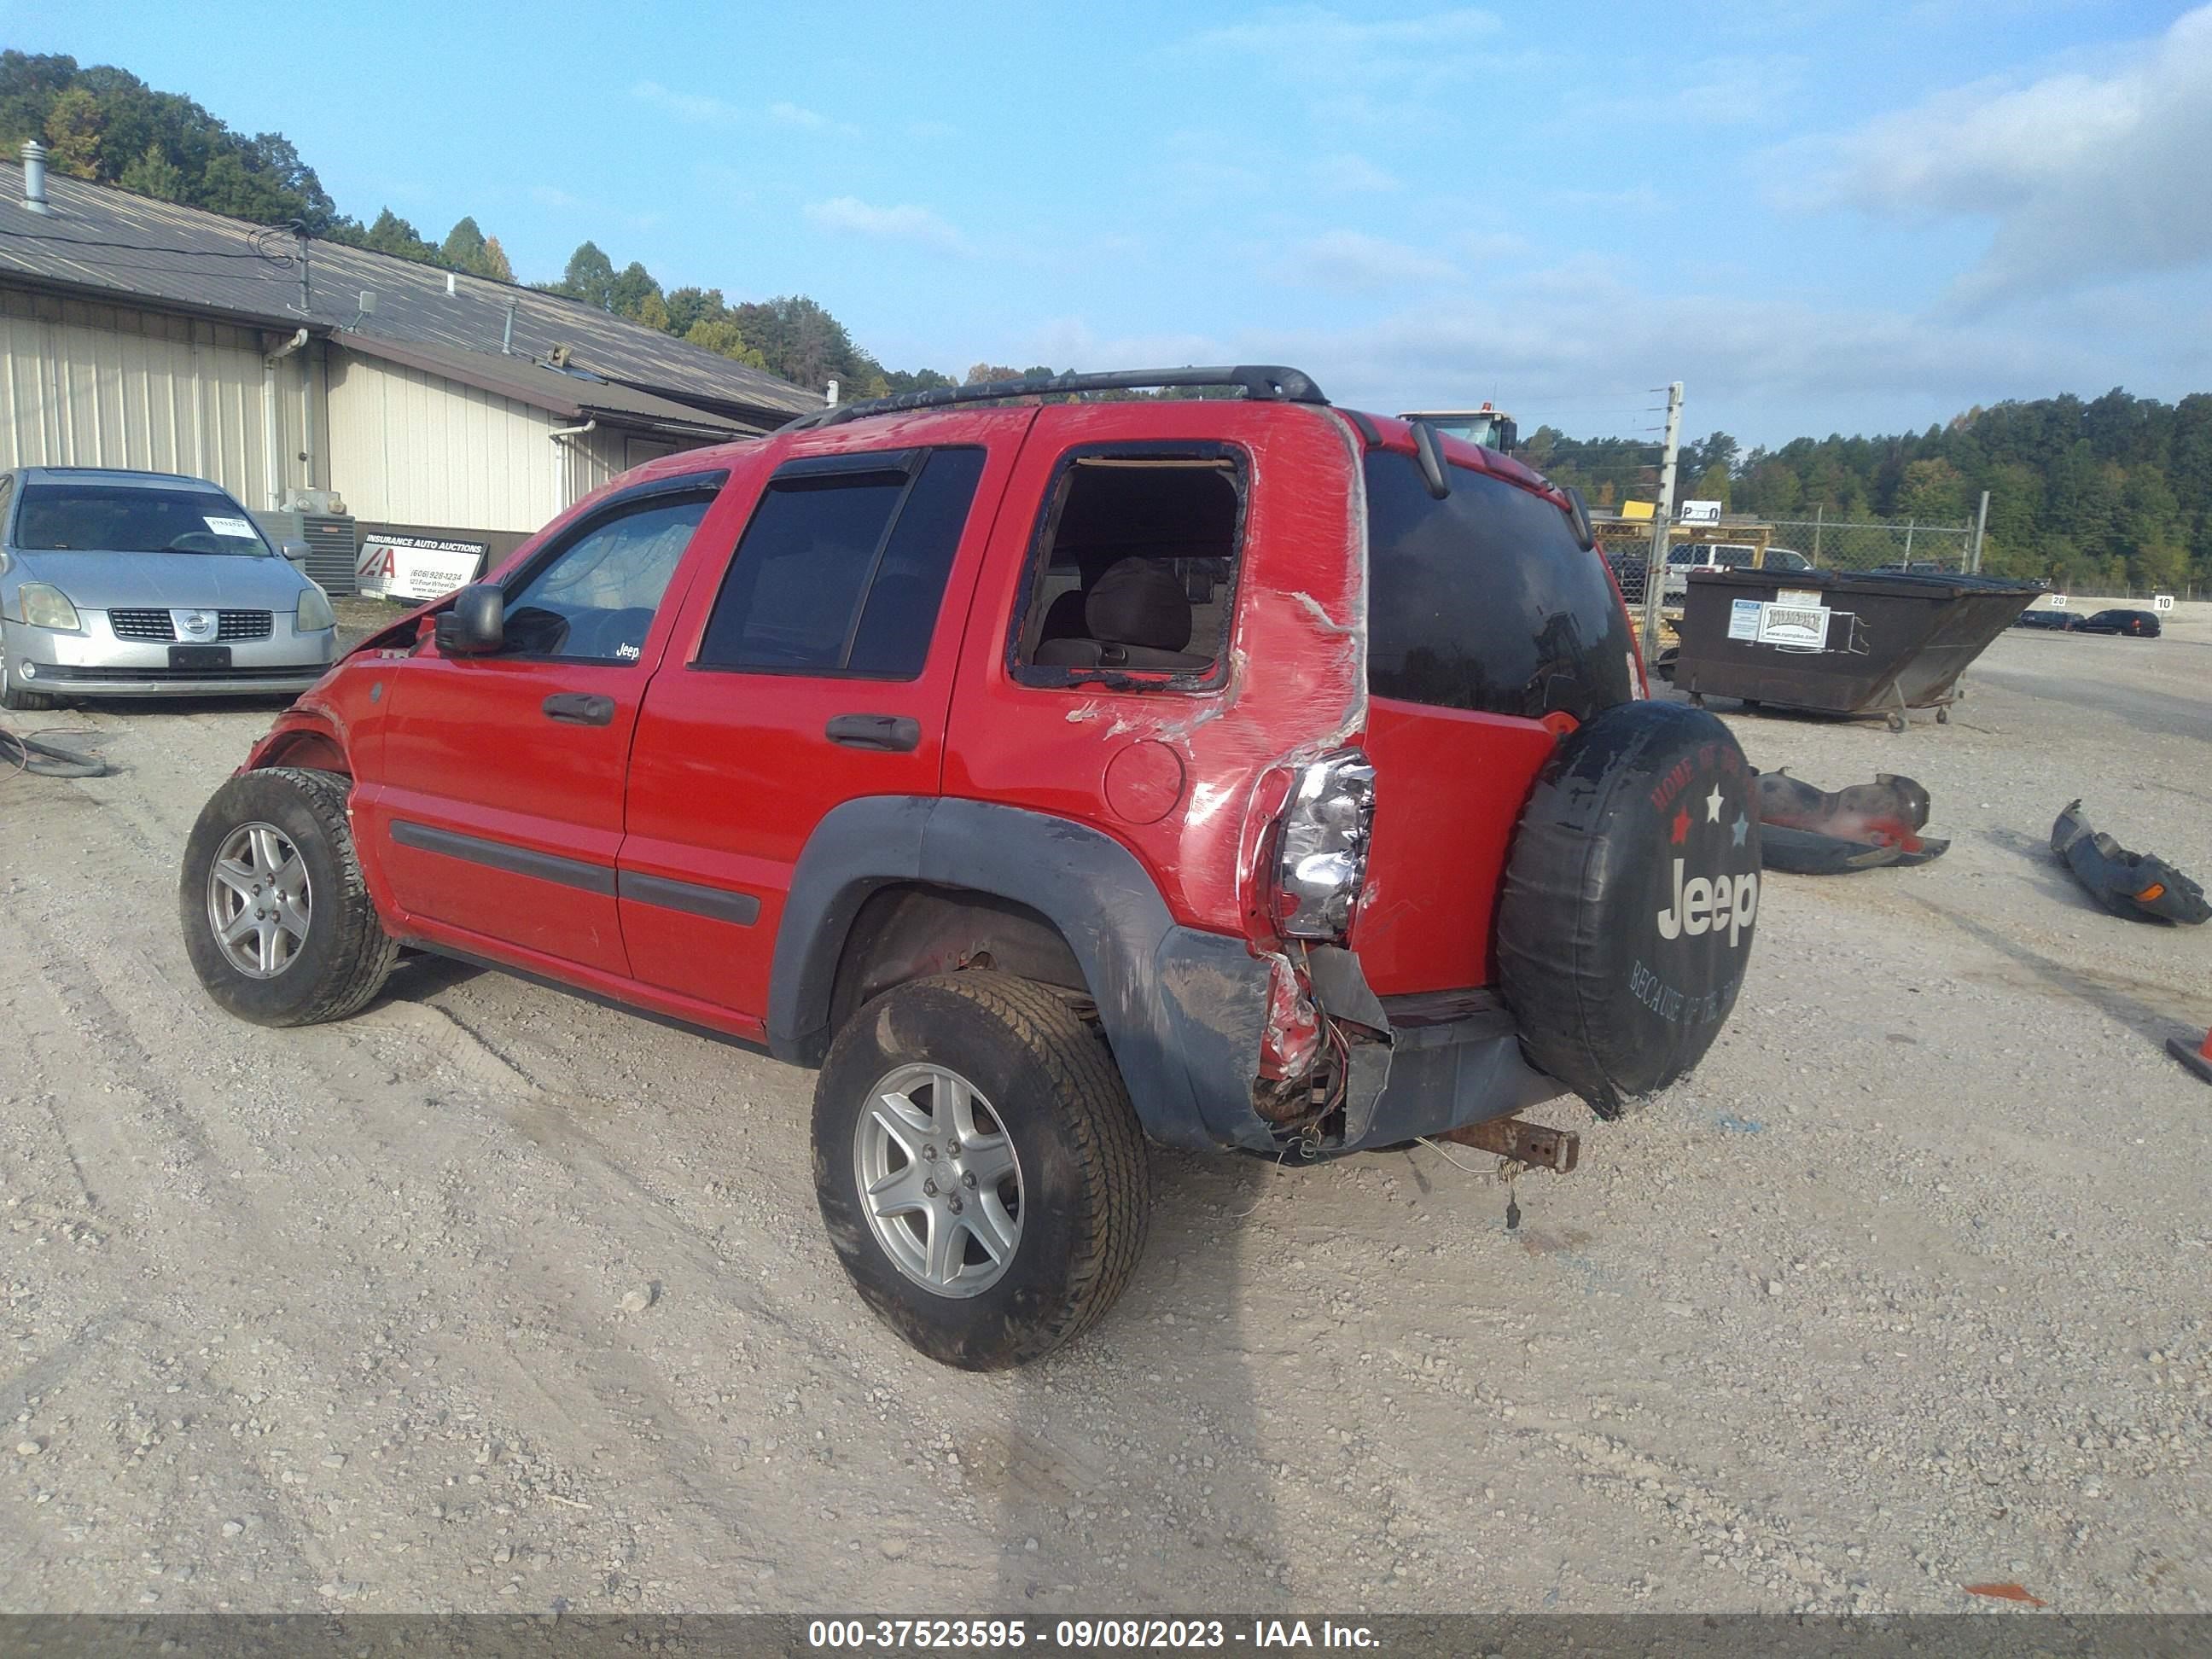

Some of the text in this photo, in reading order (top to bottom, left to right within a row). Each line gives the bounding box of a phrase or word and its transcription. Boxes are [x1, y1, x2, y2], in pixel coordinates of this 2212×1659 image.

[366, 534, 483, 554] INSURANCE AUTO AUCTIONS
[410, 569, 463, 581] (606) 928-1234
[2053, 597, 2065, 606] 20
[2157, 597, 2170, 608] 10
[615, 642, 640, 661] Jeep
[1651, 756, 1694, 813] HOME
[1657, 858, 1759, 948] Jeep
[1629, 958, 1685, 1022] BECAUSE
